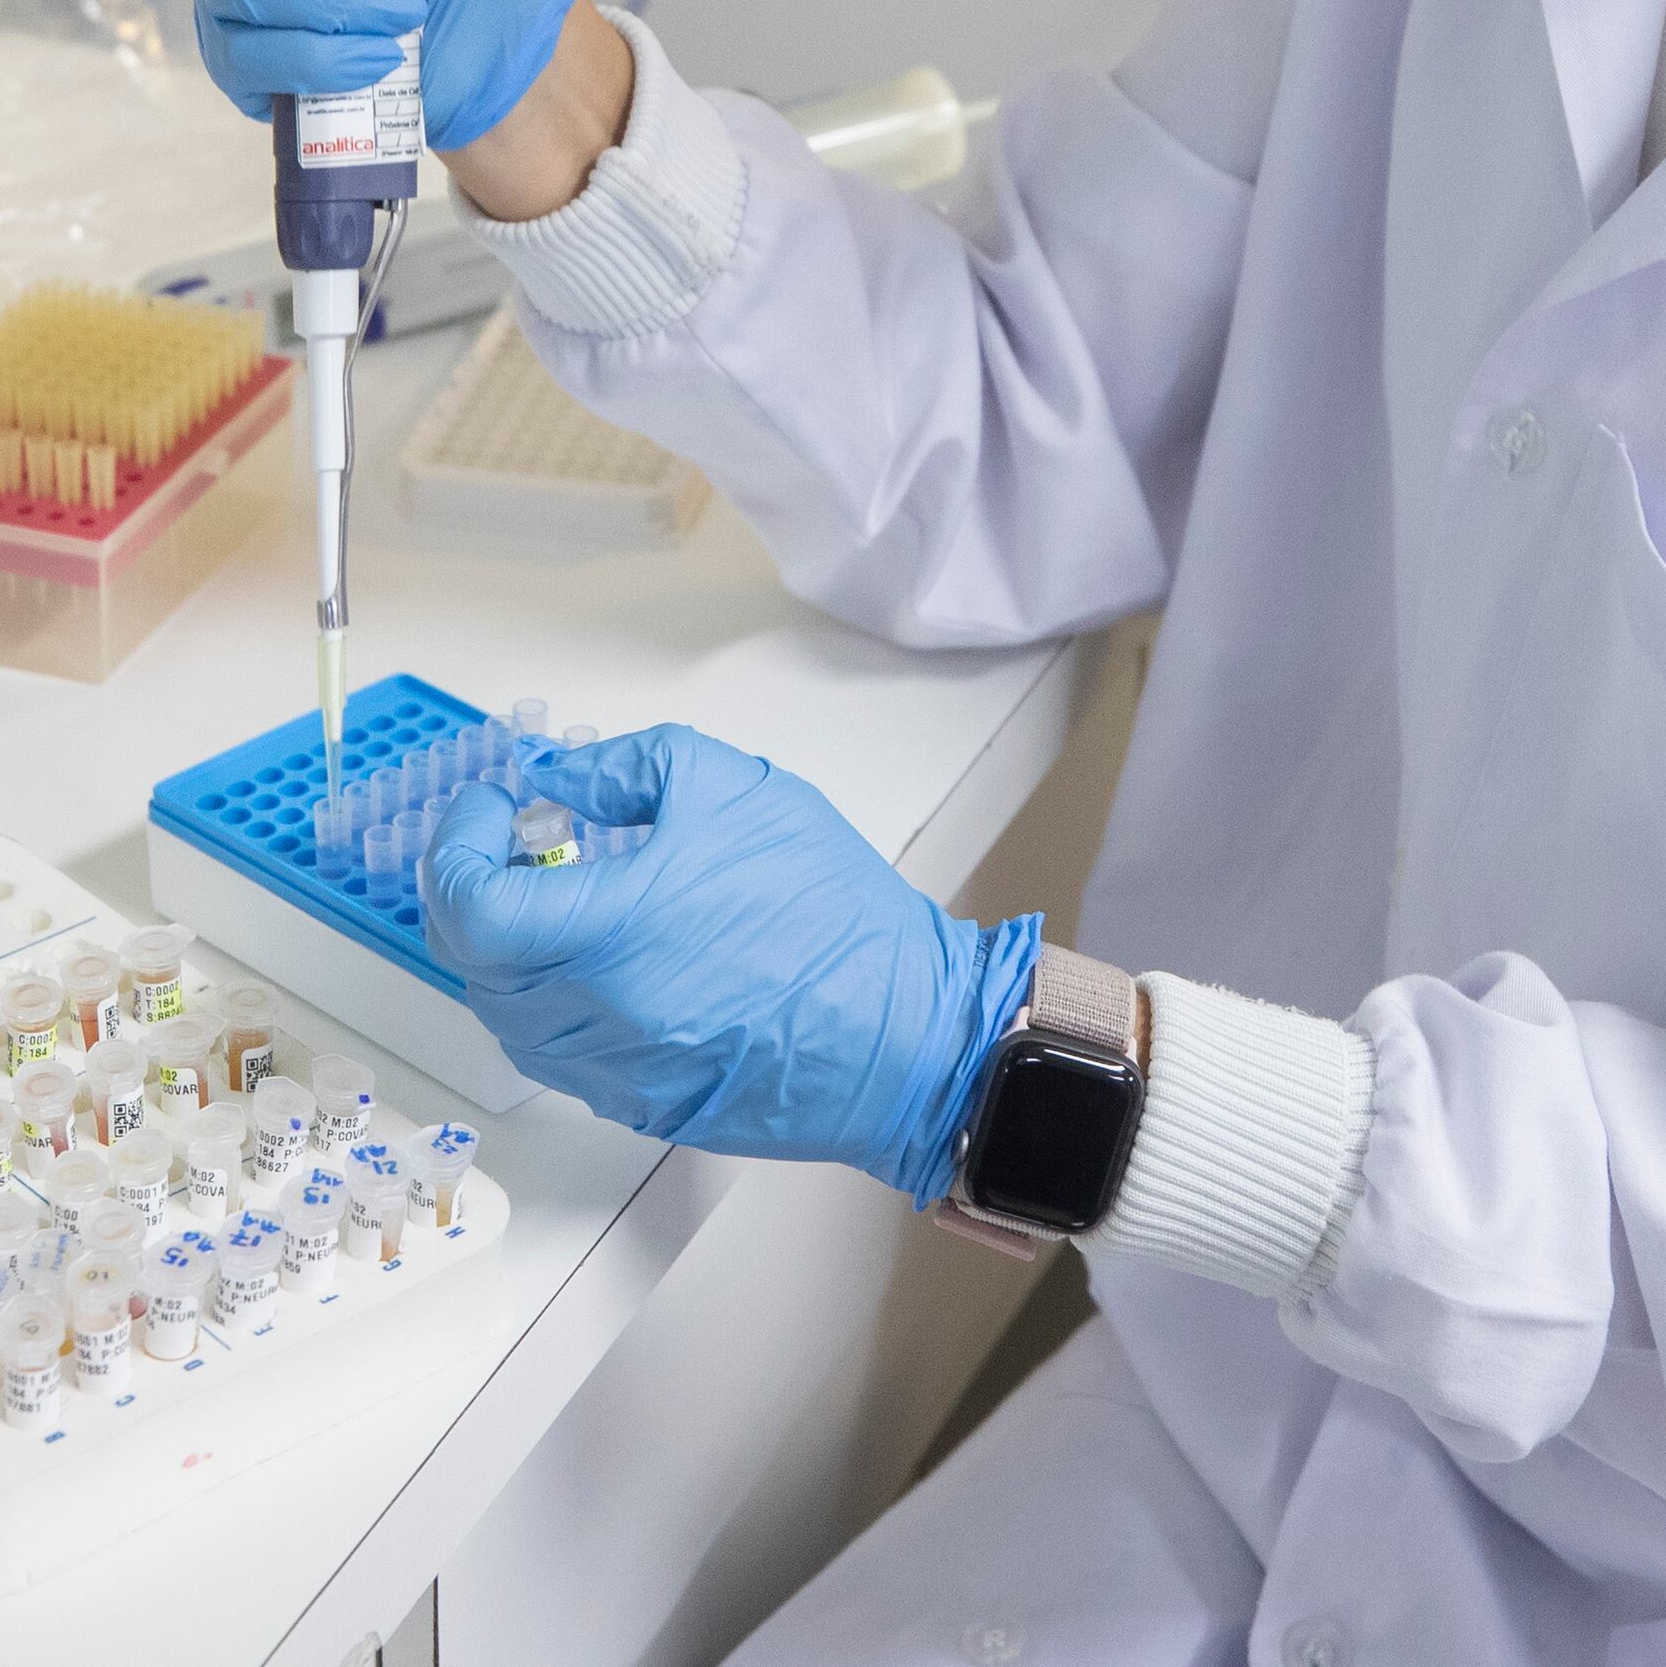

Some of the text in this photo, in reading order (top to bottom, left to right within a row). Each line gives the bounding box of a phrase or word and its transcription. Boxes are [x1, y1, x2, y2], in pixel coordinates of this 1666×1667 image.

[538, 848, 565, 865] M:02
[146, 998, 176, 1010] T:184
[18, 1047, 48, 1058] T:184
[331, 1116, 359, 1128] M:02
[120, 1183, 157, 1200] C:0001
[444, 1225, 466, 1239] H
[299, 1236, 328, 1249] M:02
[160, 1246, 190, 1267] 15
[382, 1258, 403, 1272] G
[235, 1278, 264, 1291] M:02
[183, 1358, 204, 1371] D
